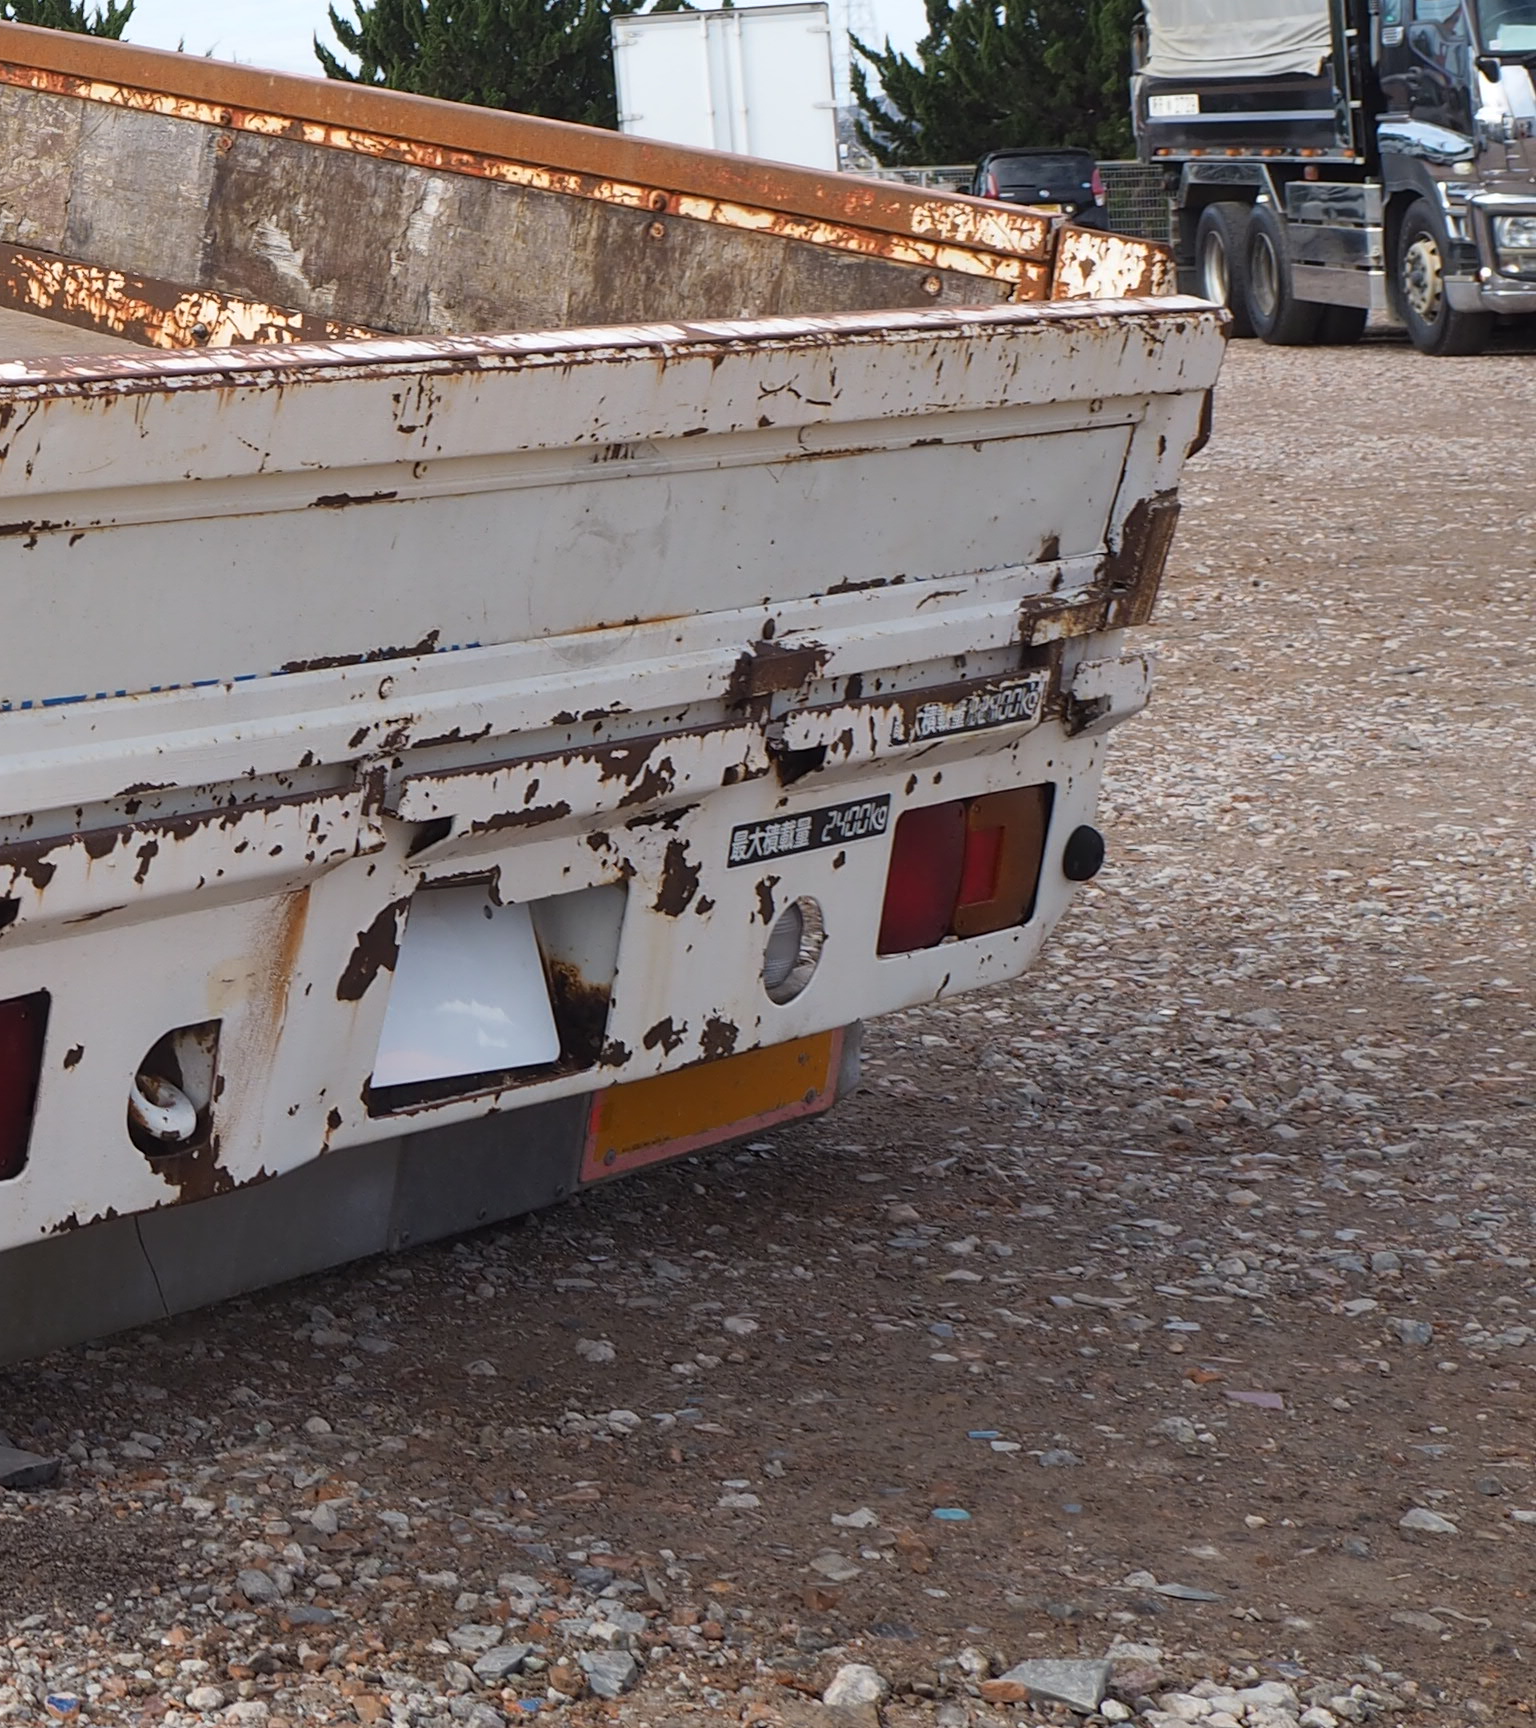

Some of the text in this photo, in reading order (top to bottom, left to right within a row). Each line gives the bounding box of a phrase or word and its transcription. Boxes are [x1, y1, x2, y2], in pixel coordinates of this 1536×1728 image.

[729, 803, 888, 861] 最大積載量 2400kg
